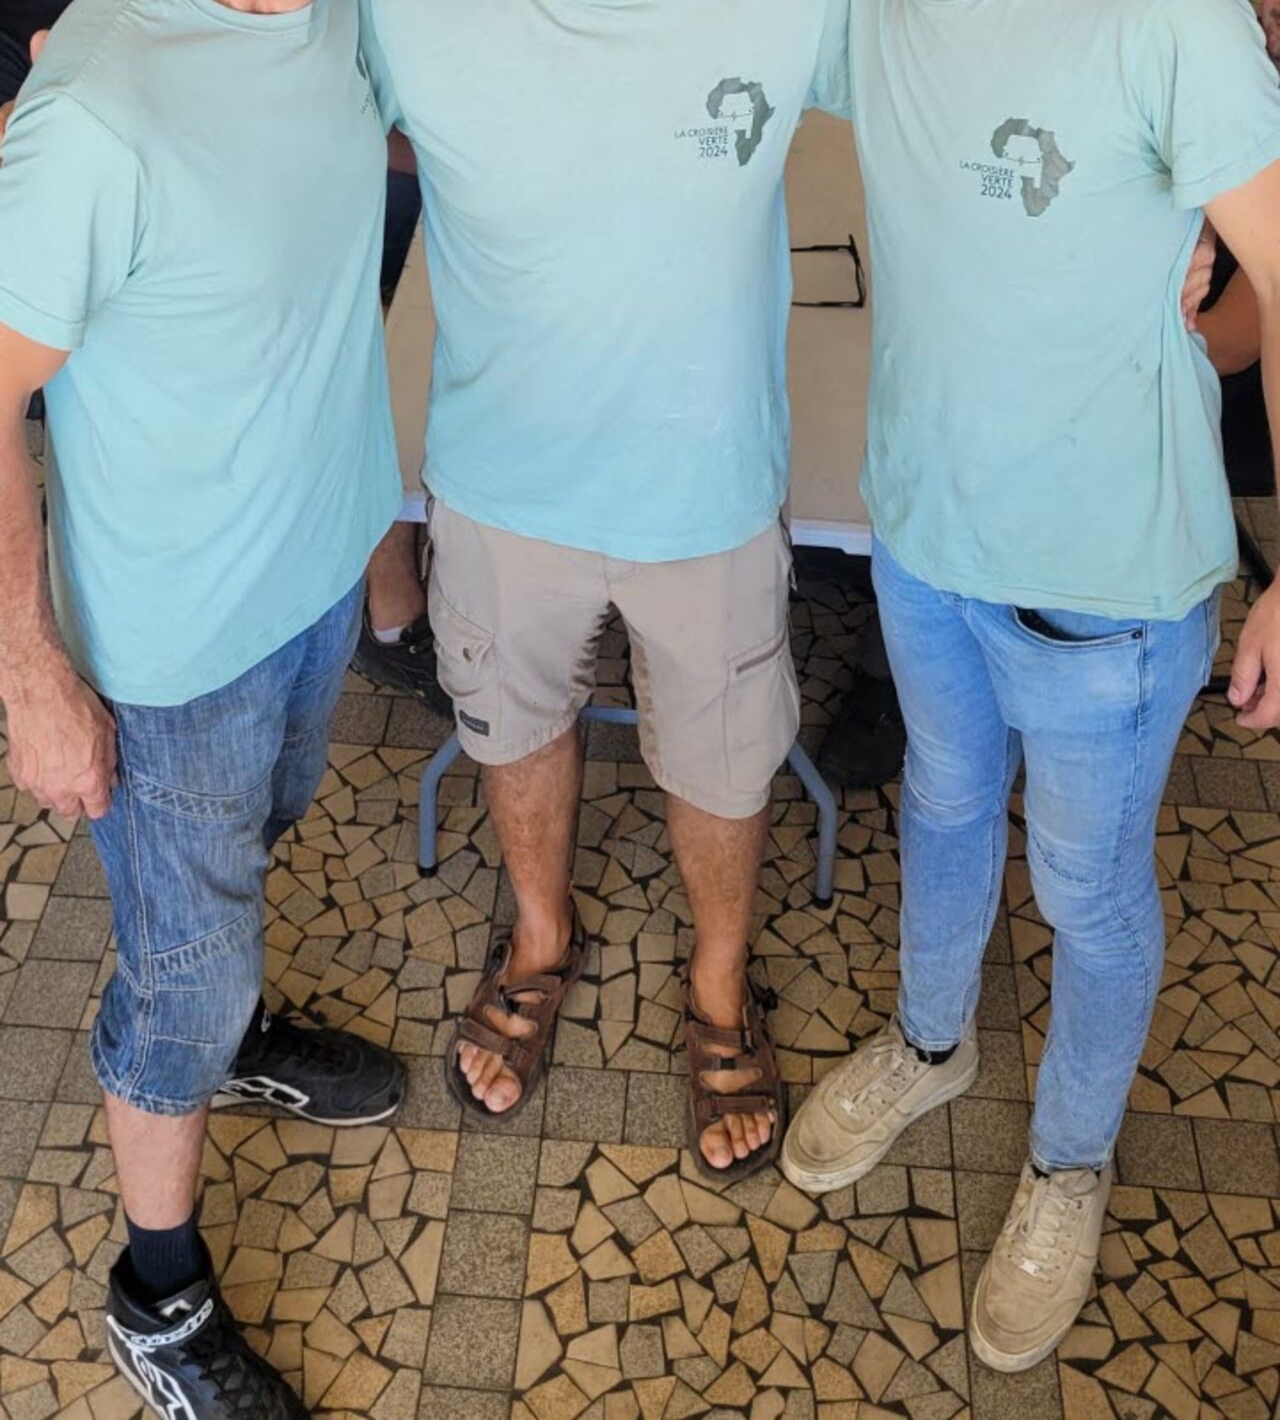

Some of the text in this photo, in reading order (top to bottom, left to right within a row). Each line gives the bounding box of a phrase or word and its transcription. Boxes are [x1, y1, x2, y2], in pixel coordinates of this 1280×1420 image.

[674, 130, 686, 139] LA
[699, 135, 728, 146] VERTE
[699, 145, 728, 157] 2024
[959, 159, 970, 169] LA
[981, 173, 1014, 189] VERTE
[980, 183, 1012, 199] 2024
